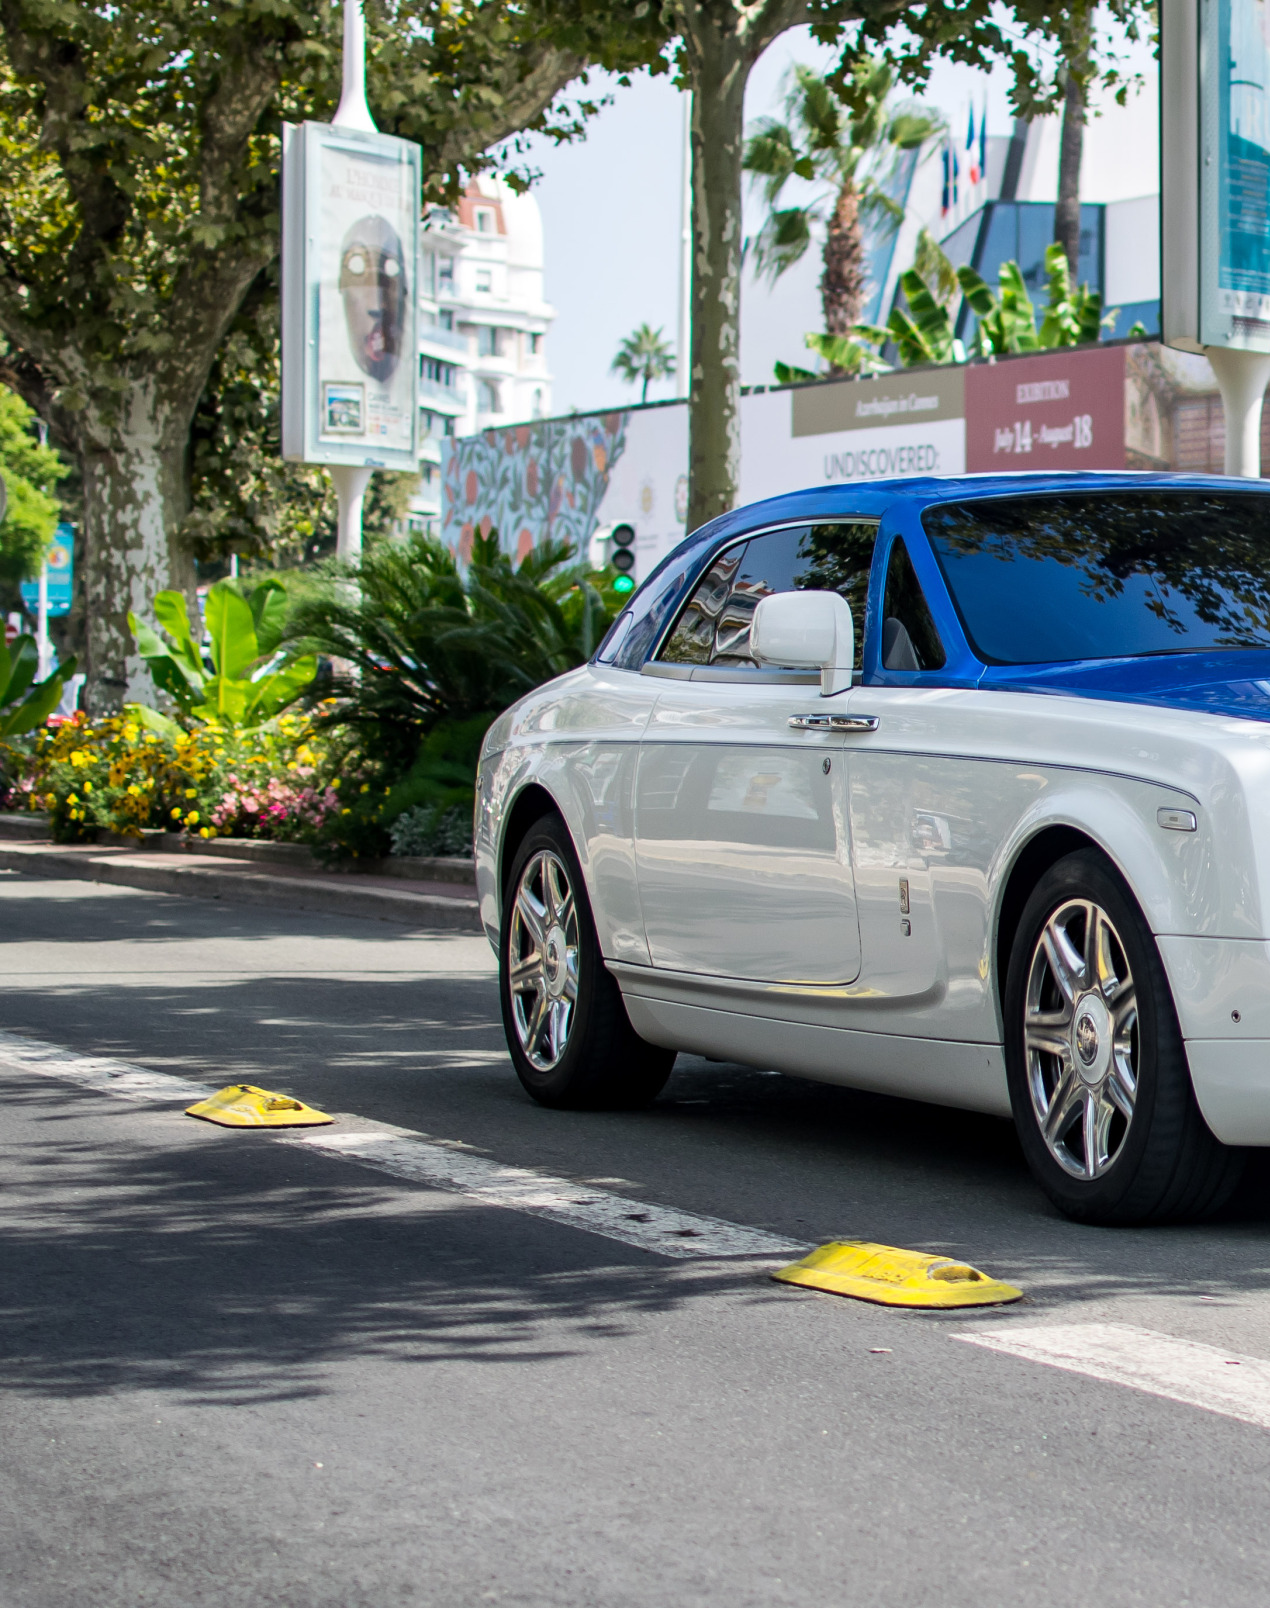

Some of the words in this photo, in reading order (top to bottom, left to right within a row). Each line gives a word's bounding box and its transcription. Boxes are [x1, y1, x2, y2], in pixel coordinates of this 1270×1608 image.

[1014, 420, 1032, 453] 14
[1038, 423, 1073, 449] August
[1073, 413, 1093, 448] 18
[823, 443, 940, 479] UNDISCOVERED:
